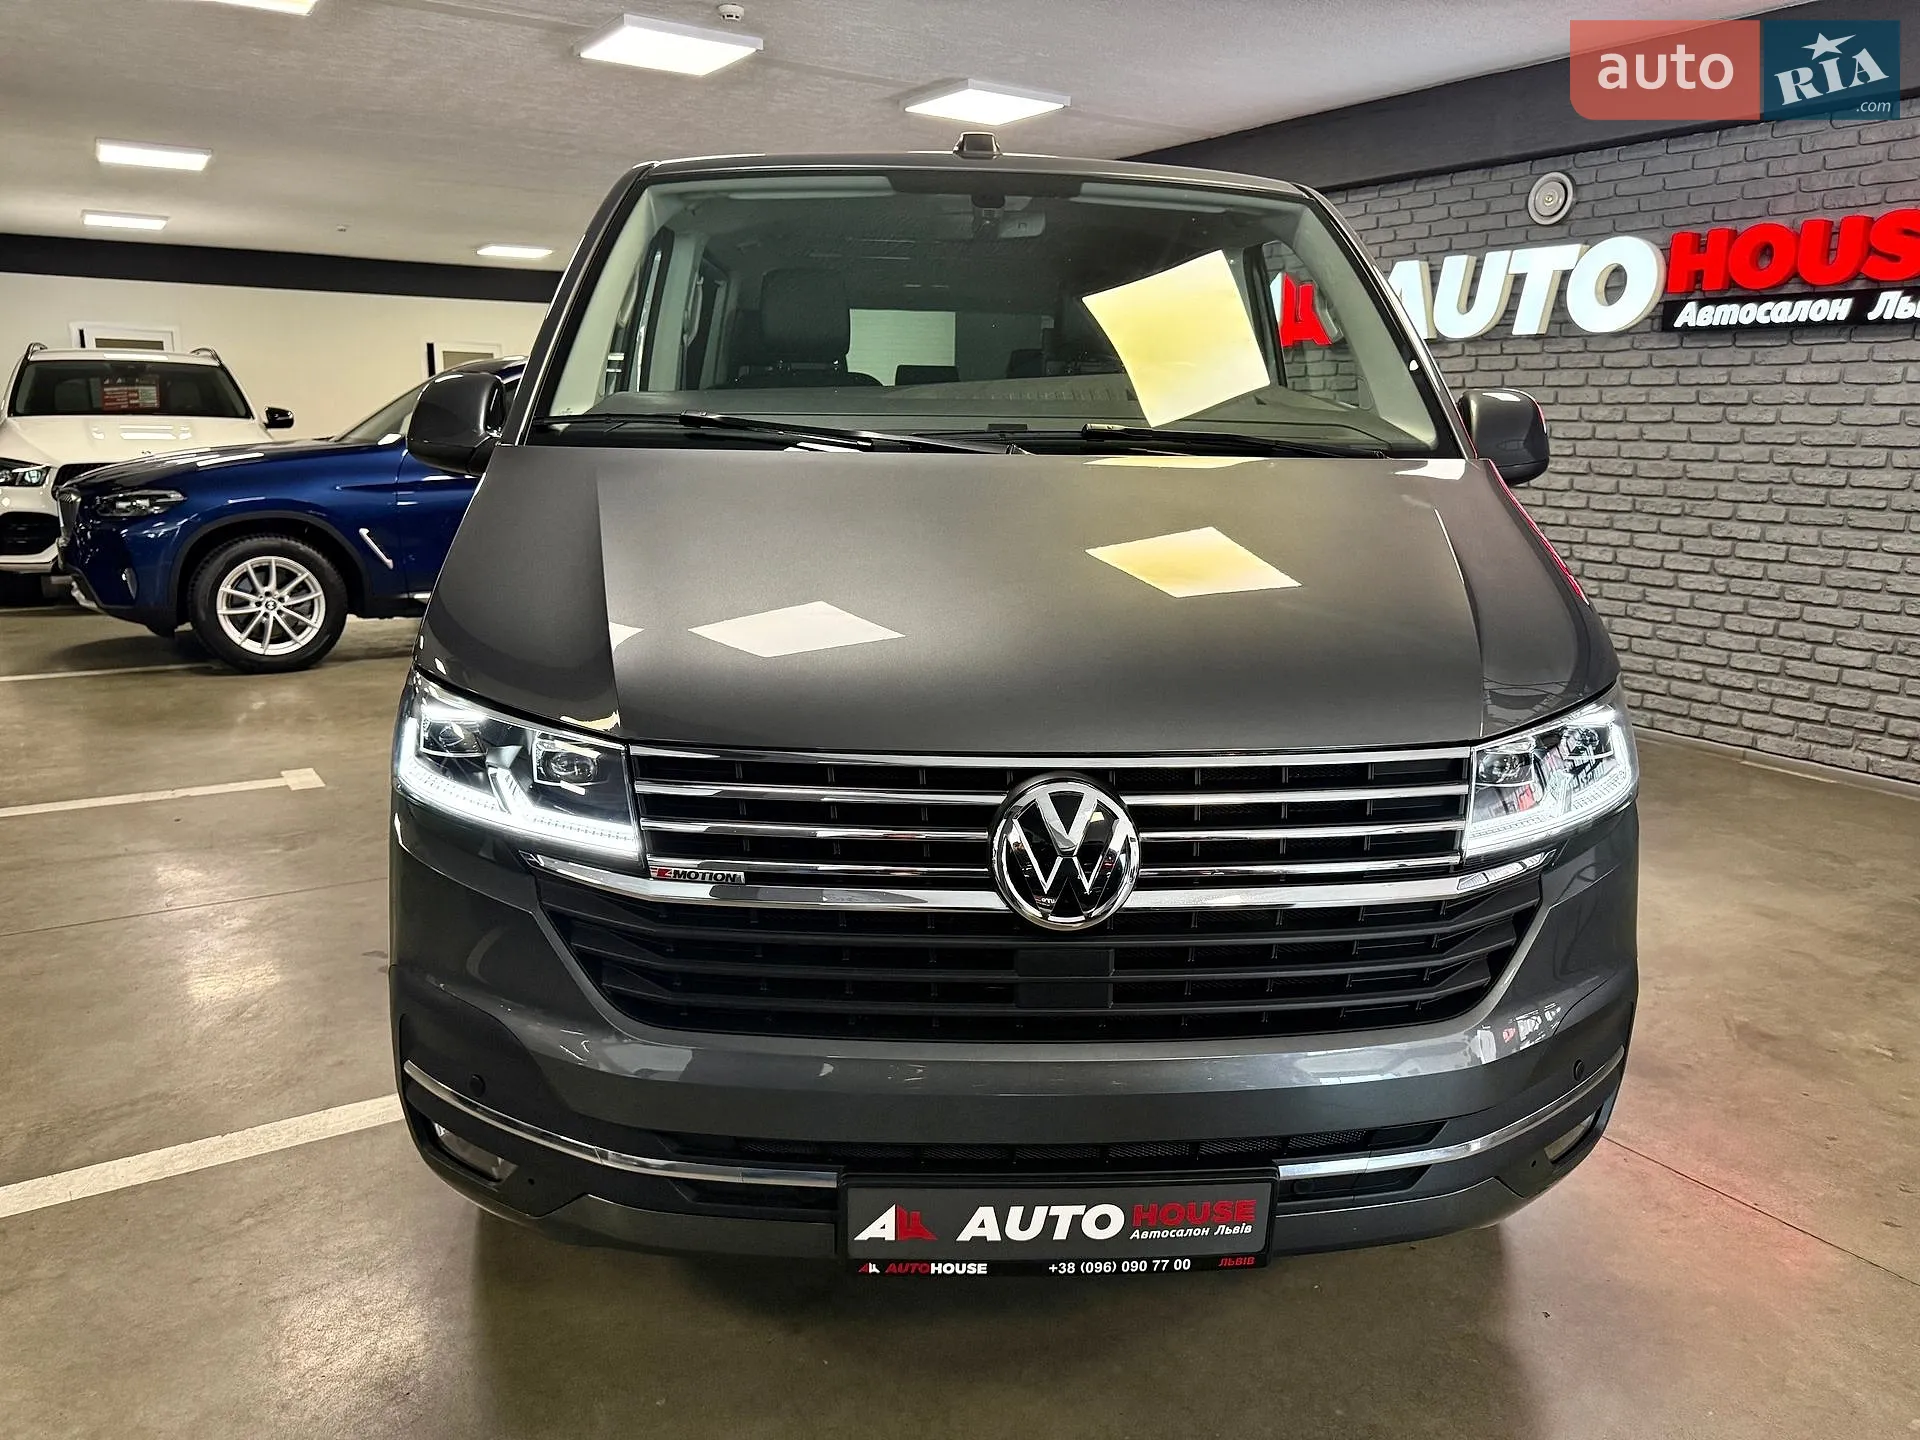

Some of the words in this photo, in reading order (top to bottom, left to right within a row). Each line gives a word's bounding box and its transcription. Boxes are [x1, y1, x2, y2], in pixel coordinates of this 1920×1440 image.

[1673, 298, 1853, 328] Автосалон
[956, 1203, 1125, 1242] AUTO
[1132, 1199, 1257, 1227] HOUSE
[1129, 1226, 1210, 1241] Автосалон
[1213, 1221, 1253, 1235] Львів
[1048, 1262, 1076, 1275] +38
[1080, 1261, 1117, 1274] (096)
[1121, 1260, 1148, 1273] 090
[1152, 1259, 1171, 1272] 77
[1173, 1258, 1191, 1271] 00
